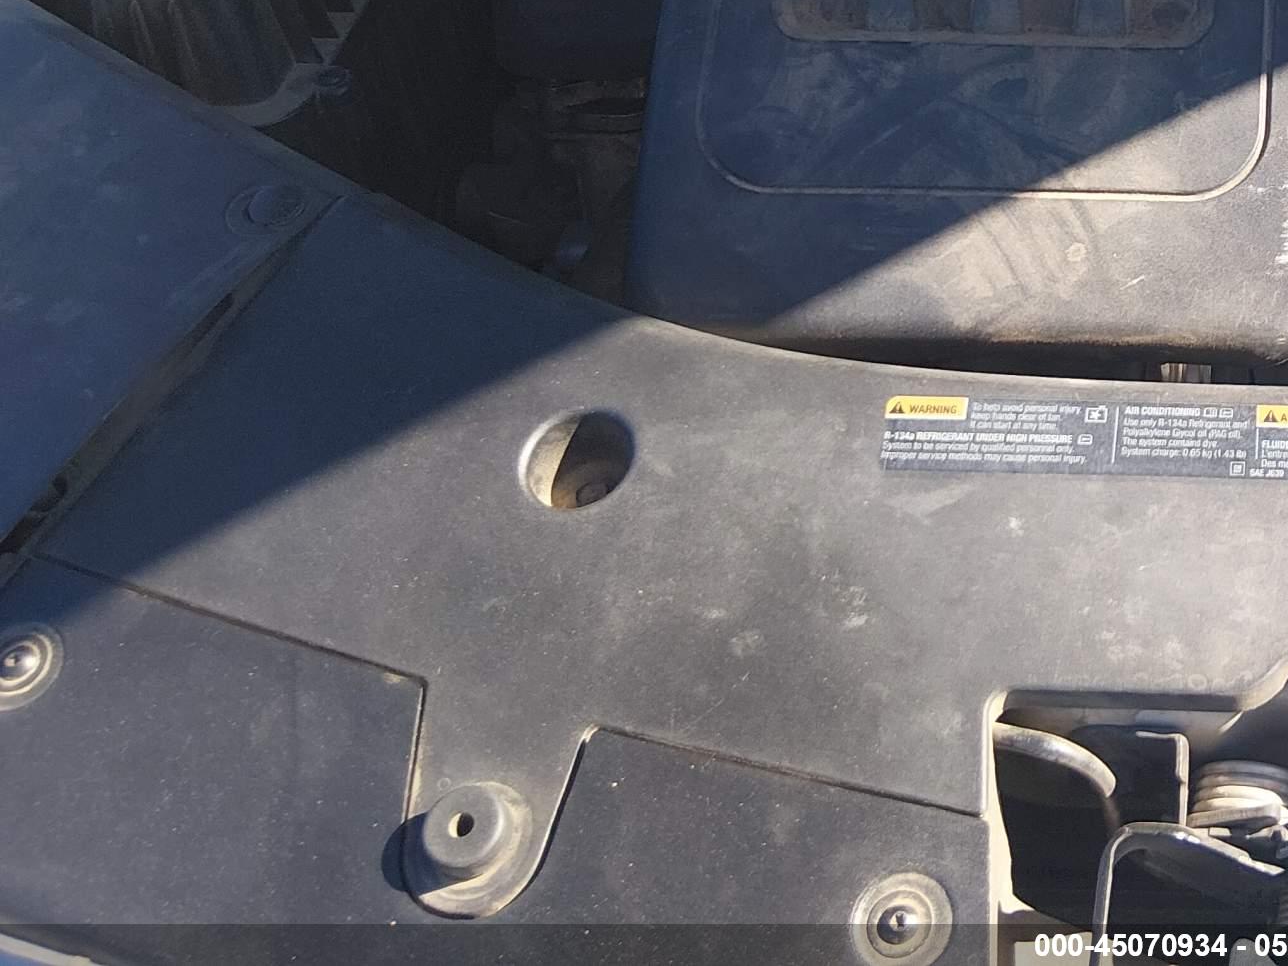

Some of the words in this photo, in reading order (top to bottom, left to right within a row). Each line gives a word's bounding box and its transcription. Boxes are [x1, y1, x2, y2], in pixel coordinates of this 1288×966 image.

[909, 404, 958, 415] WARNING
[1124, 406, 1139, 416] AIR
[1141, 407, 1201, 417] CONDITIONING
[1124, 417, 1139, 426] Use
[1140, 418, 1157, 428] only
[1158, 418, 1188, 427] R-134a
[1188, 419, 1230, 429] Refrigerant
[884, 431, 915, 441] R-134a
[916, 432, 974, 441] REFRIGERANT
[975, 432, 1005, 442] UNDER
[1006, 433, 1028, 443] HIGH
[1028, 434, 1073, 443] PRESSURE
[1123, 427, 1170, 437] Polyalkylene
[1172, 428, 1196, 438] Glycol
[1208, 429, 1227, 439] (PAG
[882, 440, 912, 451] System
[1122, 436, 1138, 445] The
[1138, 437, 1167, 447] system
[1168, 438, 1201, 447] contains
[1121, 446, 1151, 457] System
[1202, 448, 1213, 459] kg
[1261, 459, 1277, 467] Des
[1250, 468, 1265, 478] SAE
